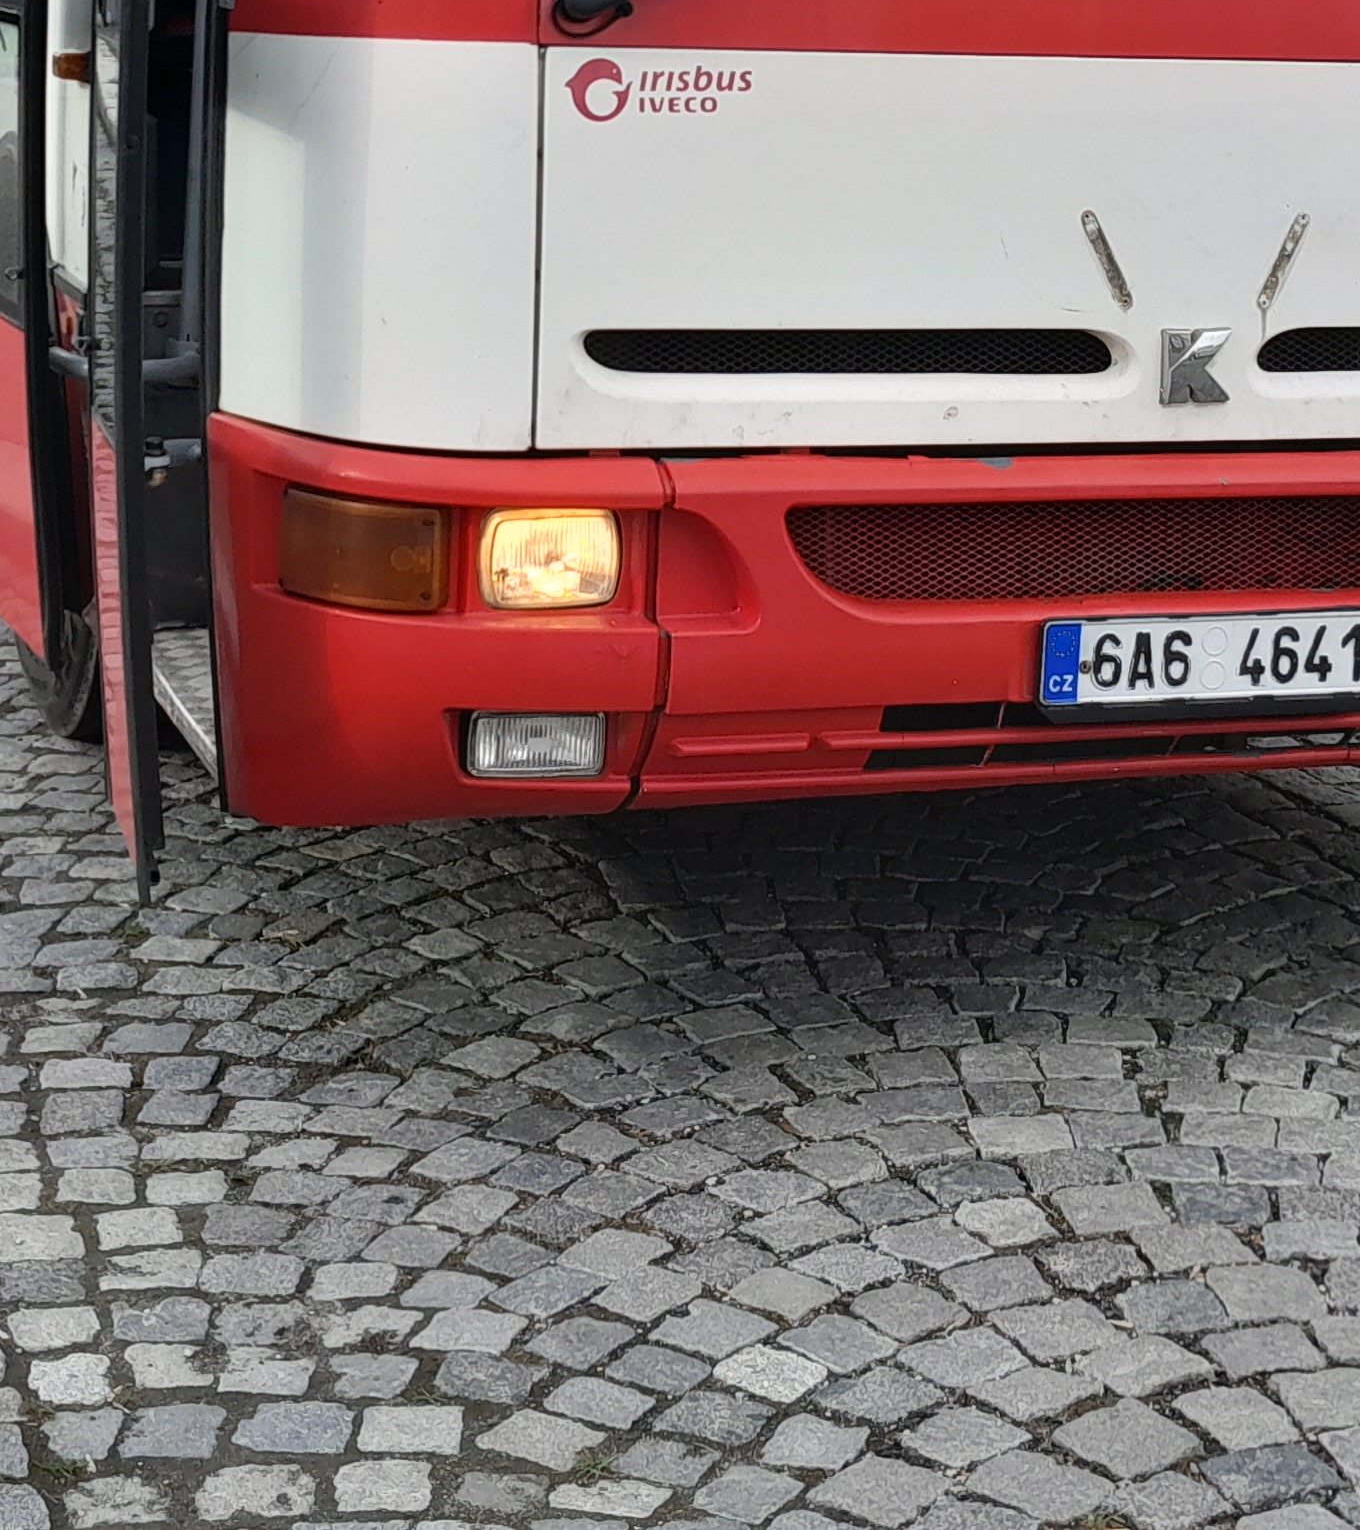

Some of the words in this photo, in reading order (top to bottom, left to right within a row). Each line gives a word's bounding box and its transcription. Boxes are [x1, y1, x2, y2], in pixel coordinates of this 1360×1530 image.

[639, 65, 752, 92] irisbus
[639, 97, 718, 113] IVECO
[1090, 629, 1193, 692] 6A6
[1048, 674, 1074, 693] CZ
